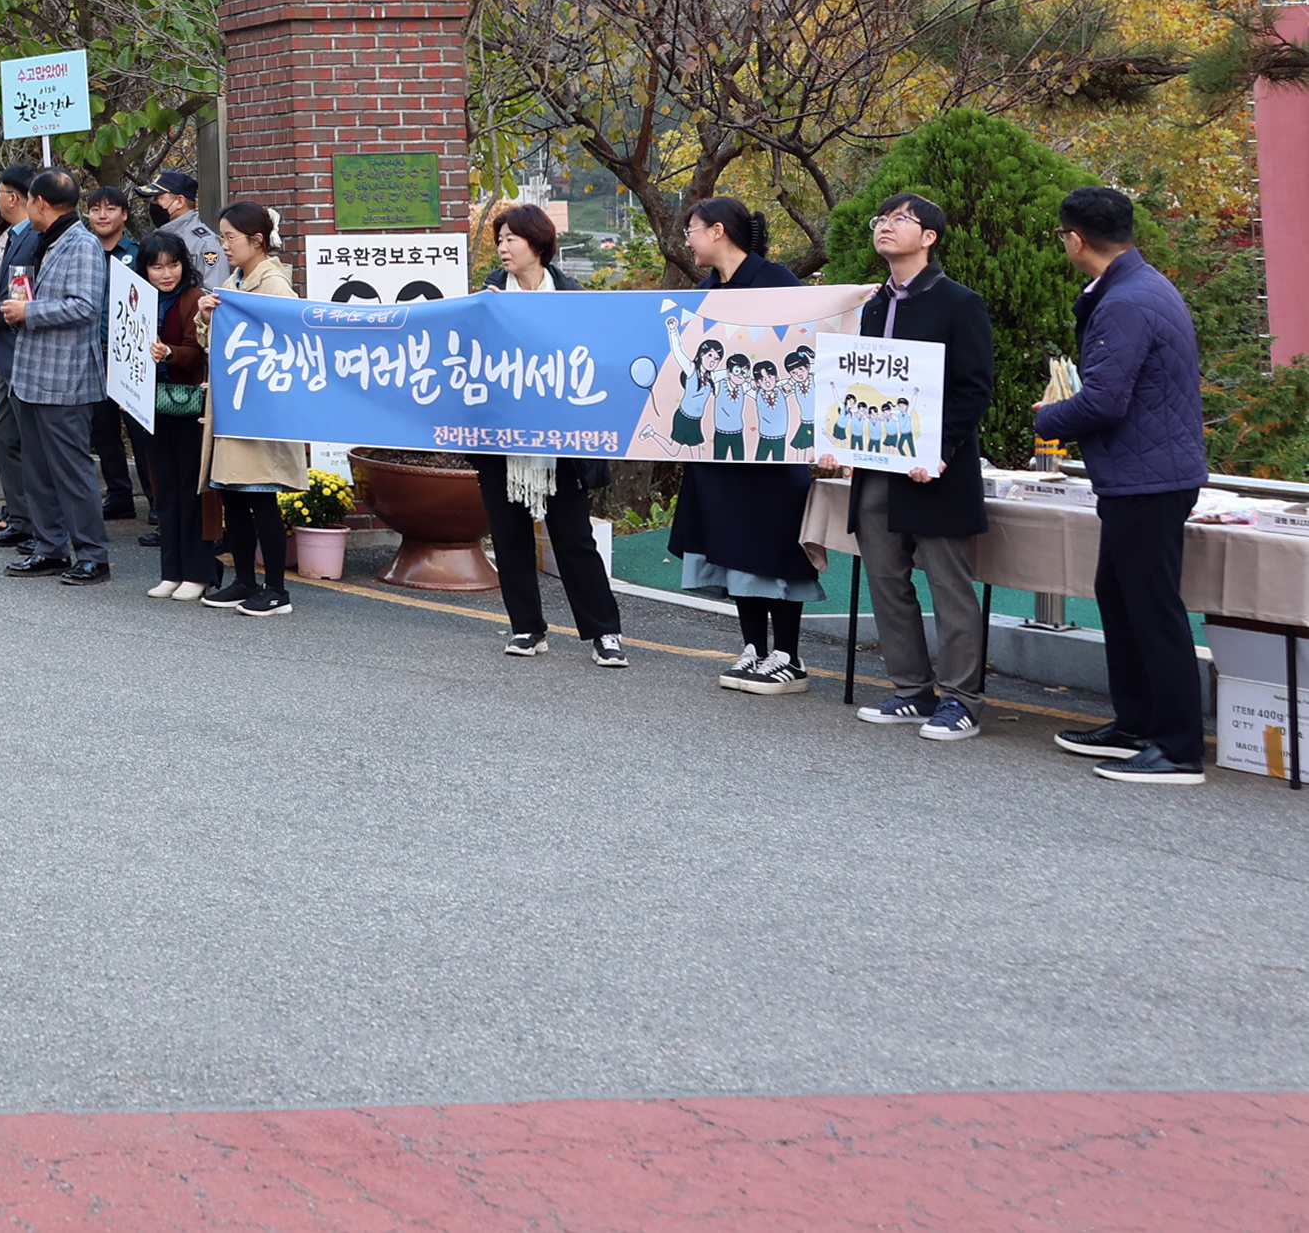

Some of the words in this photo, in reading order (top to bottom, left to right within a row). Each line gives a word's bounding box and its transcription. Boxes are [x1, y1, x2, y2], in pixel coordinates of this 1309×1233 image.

[14, 91, 48, 123] 꽃길만
[316, 246, 459, 266] 교육환경보호구역
[224, 322, 326, 410] 수험생
[335, 329, 441, 406] 여러분
[442, 330, 608, 406] 힘내세요
[839, 351, 910, 382] 대박기원
[433, 425, 620, 452] 전라남도진도교육지원청
[1232, 704, 1255, 716] ITEM
[1257, 709, 1284, 723] 400g
[1235, 742, 1259, 752] MADE
